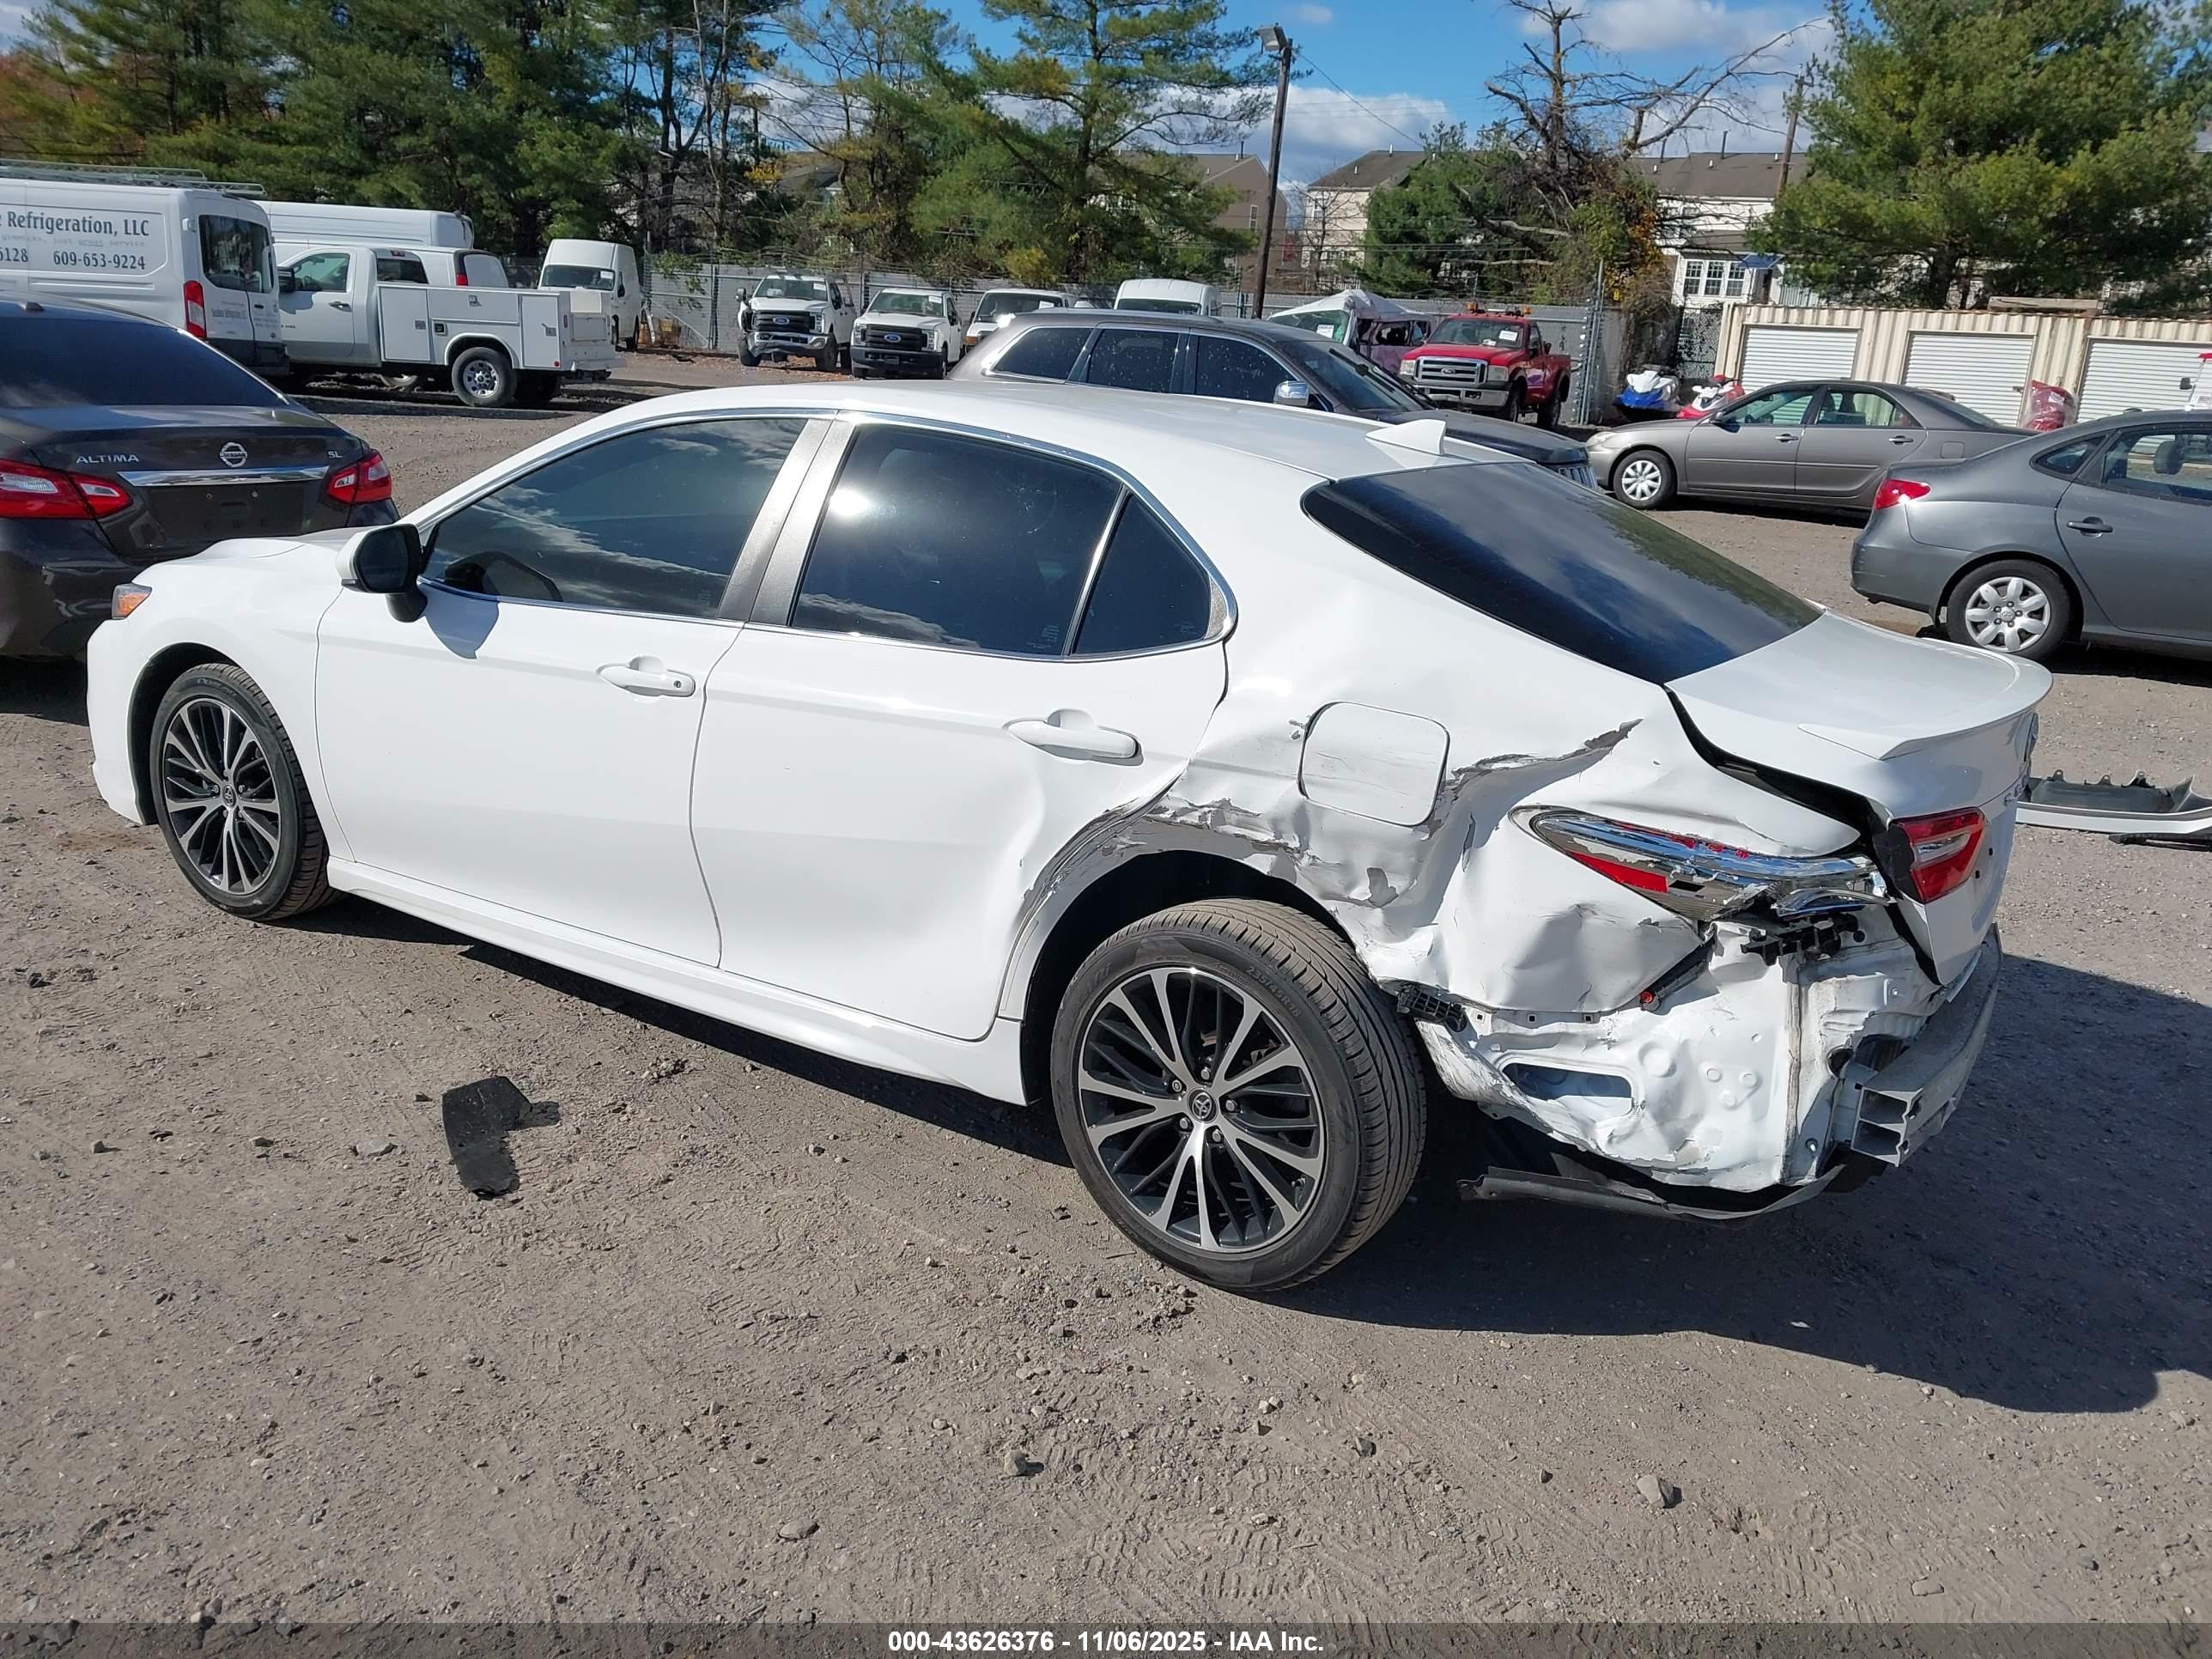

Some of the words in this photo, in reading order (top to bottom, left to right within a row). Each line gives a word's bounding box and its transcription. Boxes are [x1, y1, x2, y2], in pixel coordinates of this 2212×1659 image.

[7, 211, 118, 237] Refrigeration,
[124, 219, 149, 236] LLC
[53, 251, 146, 270] 609-653-9224
[76, 454, 140, 464] ALTIMA
